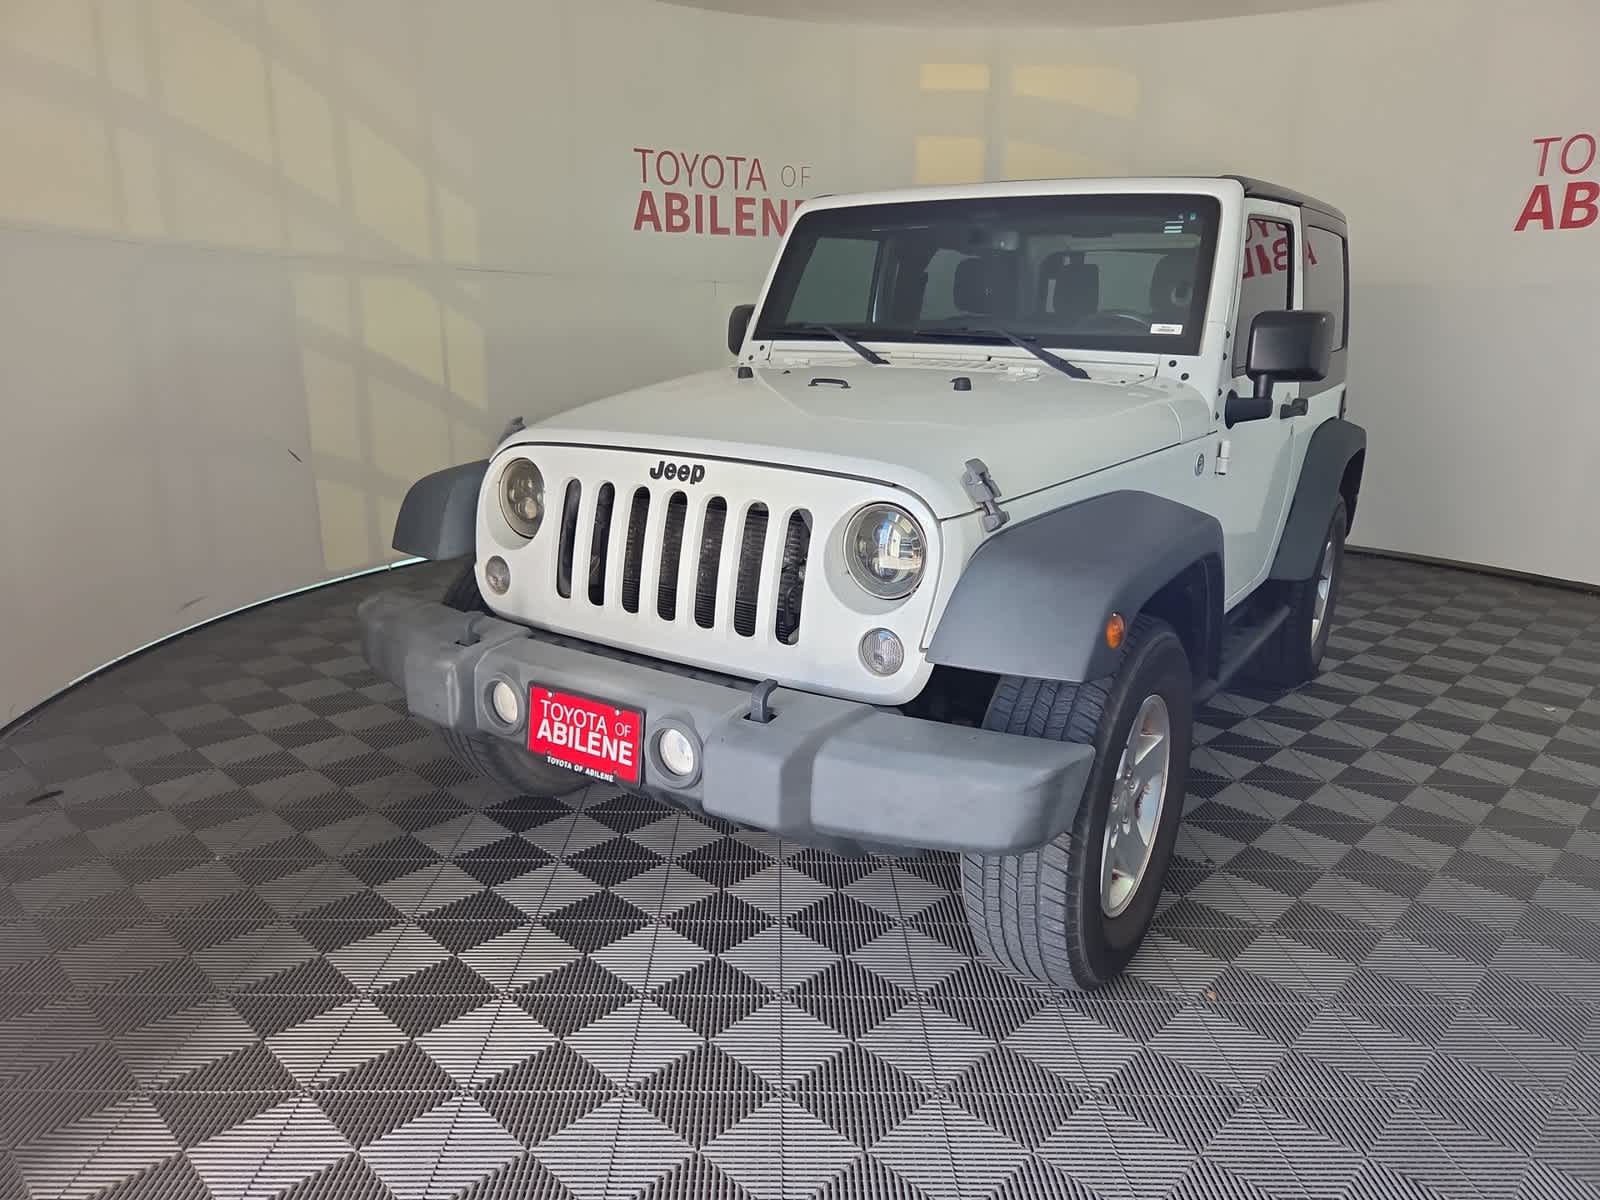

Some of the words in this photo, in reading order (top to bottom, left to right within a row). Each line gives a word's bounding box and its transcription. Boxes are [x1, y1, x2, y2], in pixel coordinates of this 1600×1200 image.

[633, 147, 767, 191] TOYOTA
[780, 164, 812, 188] OF
[649, 460, 706, 485] Jeep
[540, 699, 608, 735] TOYOTA
[614, 722, 633, 737] OF
[536, 718, 634, 767] ABILENE
[546, 755, 572, 770] TOYOTA
[573, 764, 584, 773] OF
[584, 768, 614, 783] ABILENE
